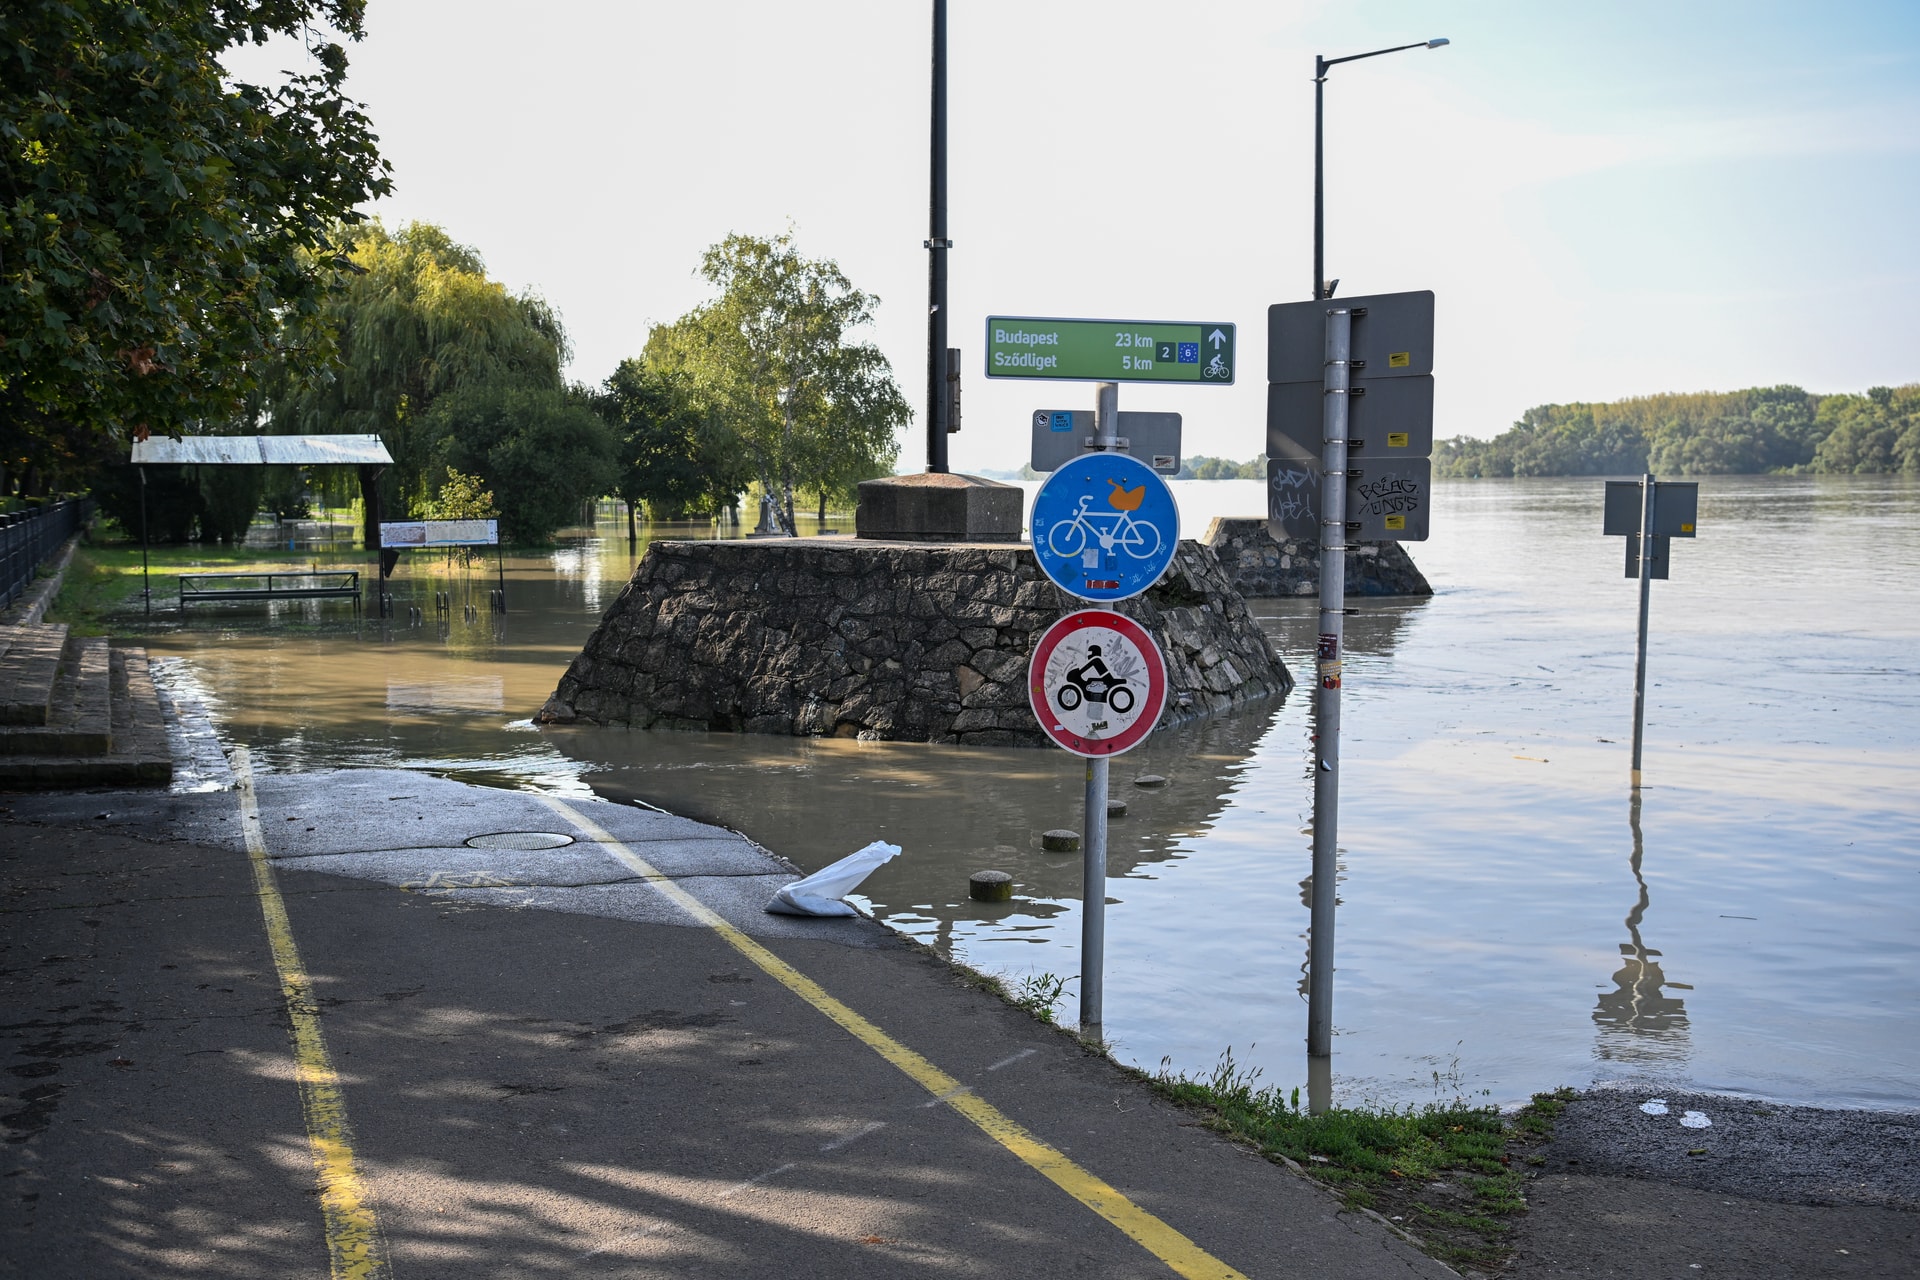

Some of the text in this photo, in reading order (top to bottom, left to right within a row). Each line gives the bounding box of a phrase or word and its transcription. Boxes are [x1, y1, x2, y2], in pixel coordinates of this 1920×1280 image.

[995, 329, 1058, 347] Budapest
[1115, 333, 1153, 348] 23 km
[1162, 347, 1170, 358] 2
[1185, 349, 1191, 357] 6
[995, 352, 1057, 371] Sződliget
[1122, 356, 1153, 370] 5 km
